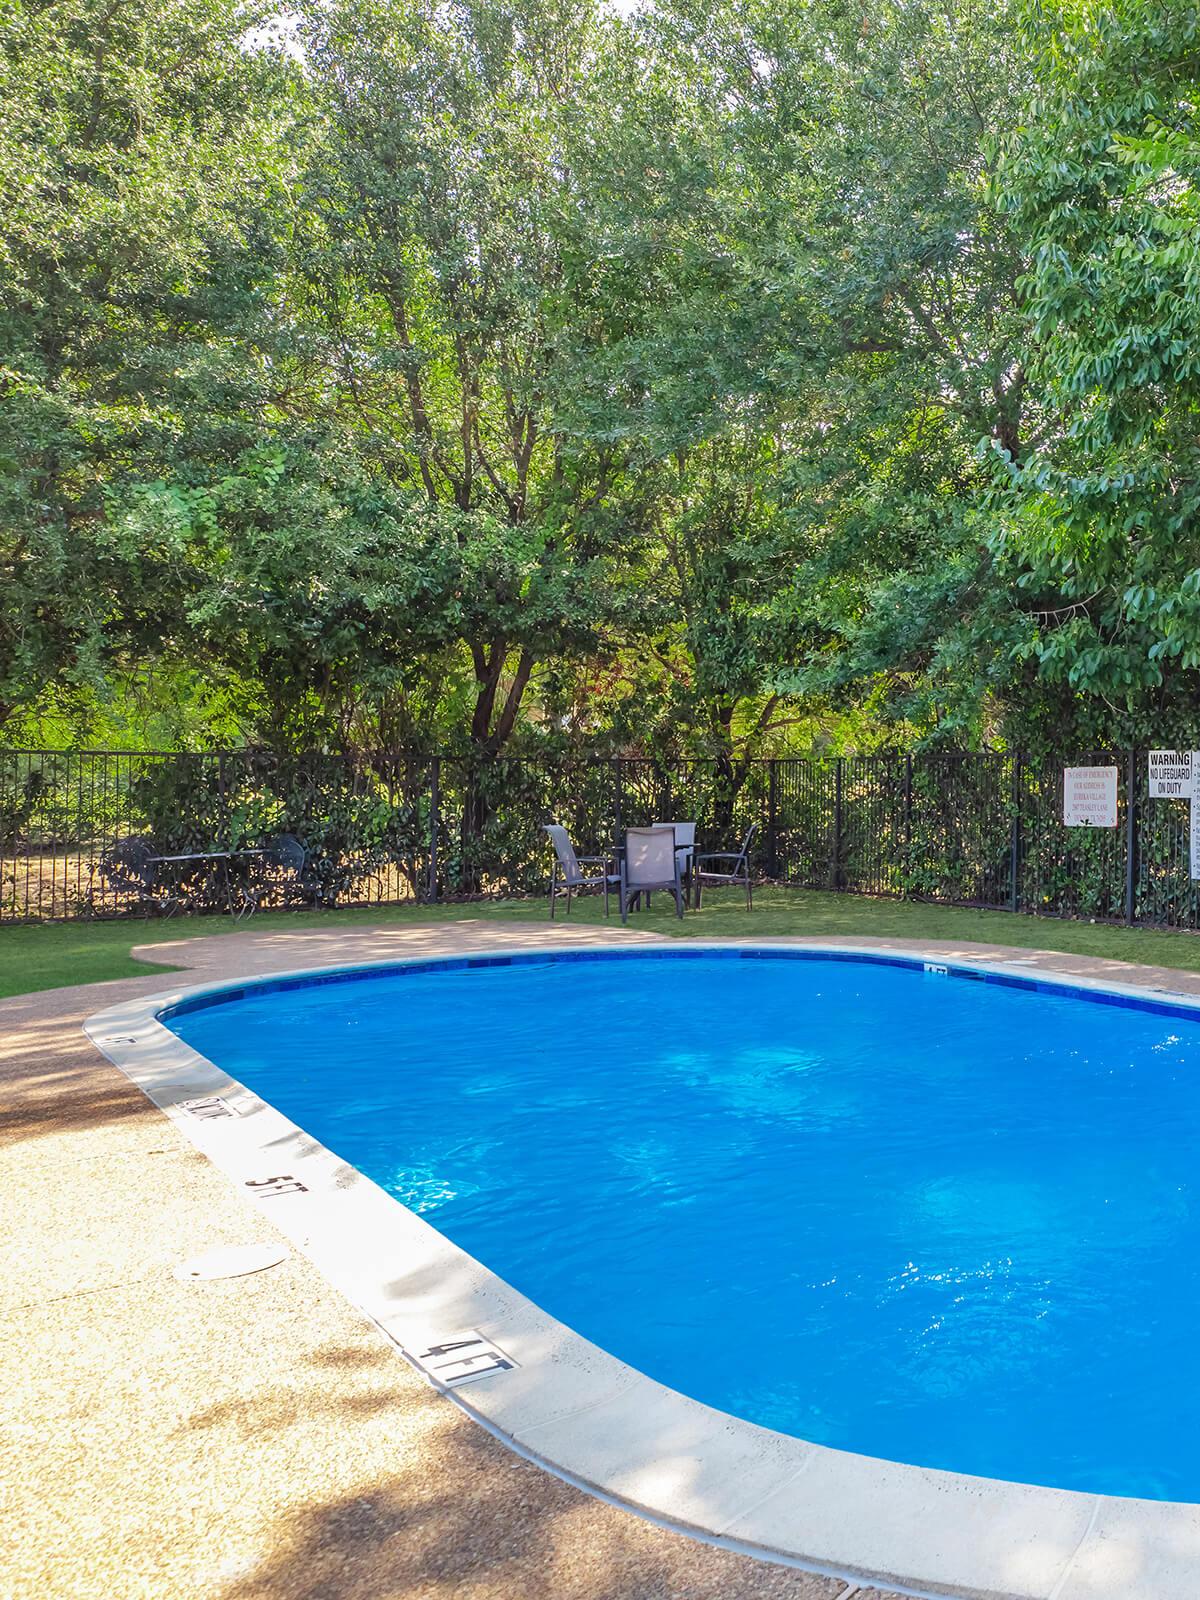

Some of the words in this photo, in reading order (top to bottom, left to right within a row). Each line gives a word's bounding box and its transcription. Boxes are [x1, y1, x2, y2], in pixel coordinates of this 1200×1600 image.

[1150, 753, 1190, 766] WARNING
[1150, 768, 1158, 779] NO
[1160, 768, 1190, 780] LIFEGUARD
[1158, 782, 1166, 794] ON
[1167, 782, 1182, 794] DUTY
[245, 1175, 294, 1187] 5
[253, 1182, 309, 1199] FT
[419, 1338, 483, 1358] 4
[433, 1351, 515, 1383] FT
